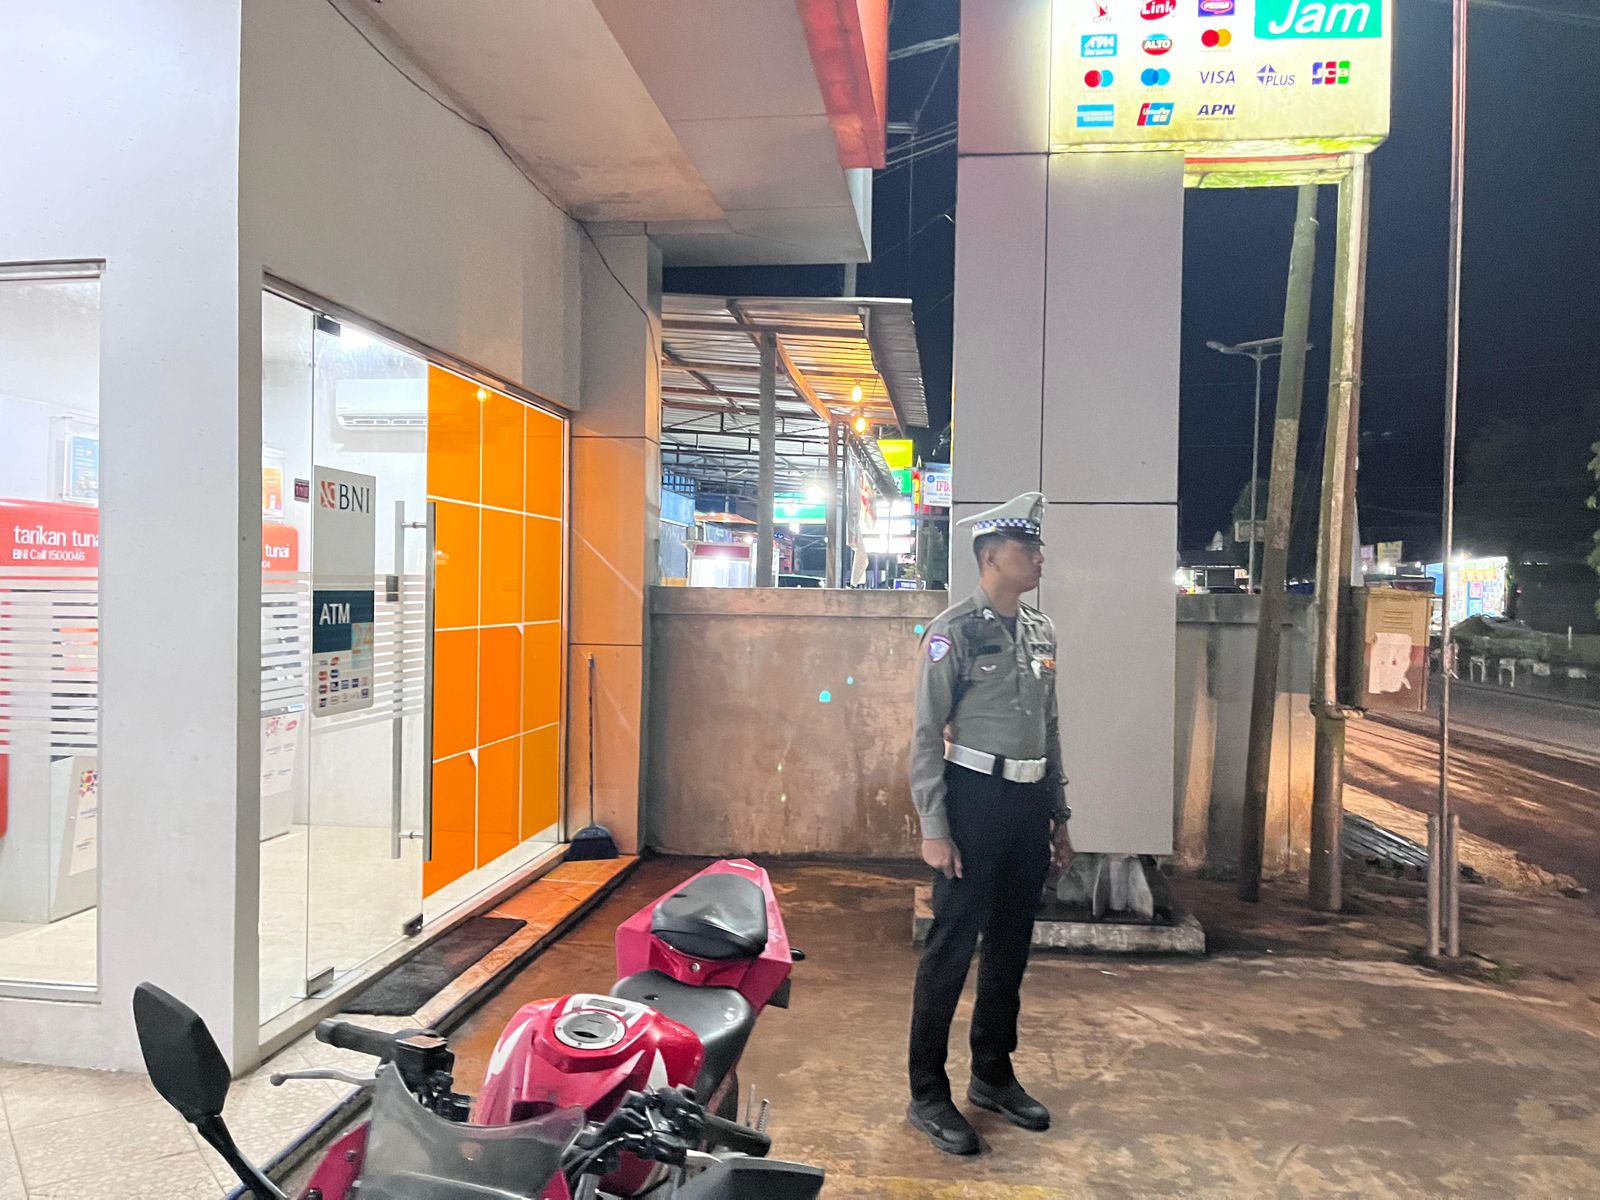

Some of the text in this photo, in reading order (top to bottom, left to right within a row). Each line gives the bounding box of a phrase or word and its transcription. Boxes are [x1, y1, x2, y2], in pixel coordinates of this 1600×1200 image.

[1141, 0, 1175, 15] Link
[1267, 0, 1371, 34] Jam
[1084, 36, 1114, 48] ATM
[1144, 39, 1171, 49] ALTO
[1200, 70, 1236, 84] VISA
[1312, 64, 1350, 80] JCB
[1264, 74, 1296, 87] PLUS
[1197, 104, 1237, 116] APN
[339, 483, 370, 514] BNI
[13, 524, 67, 547] tarikan
[265, 543, 290, 558] tunai
[319, 602, 351, 626] ATM
